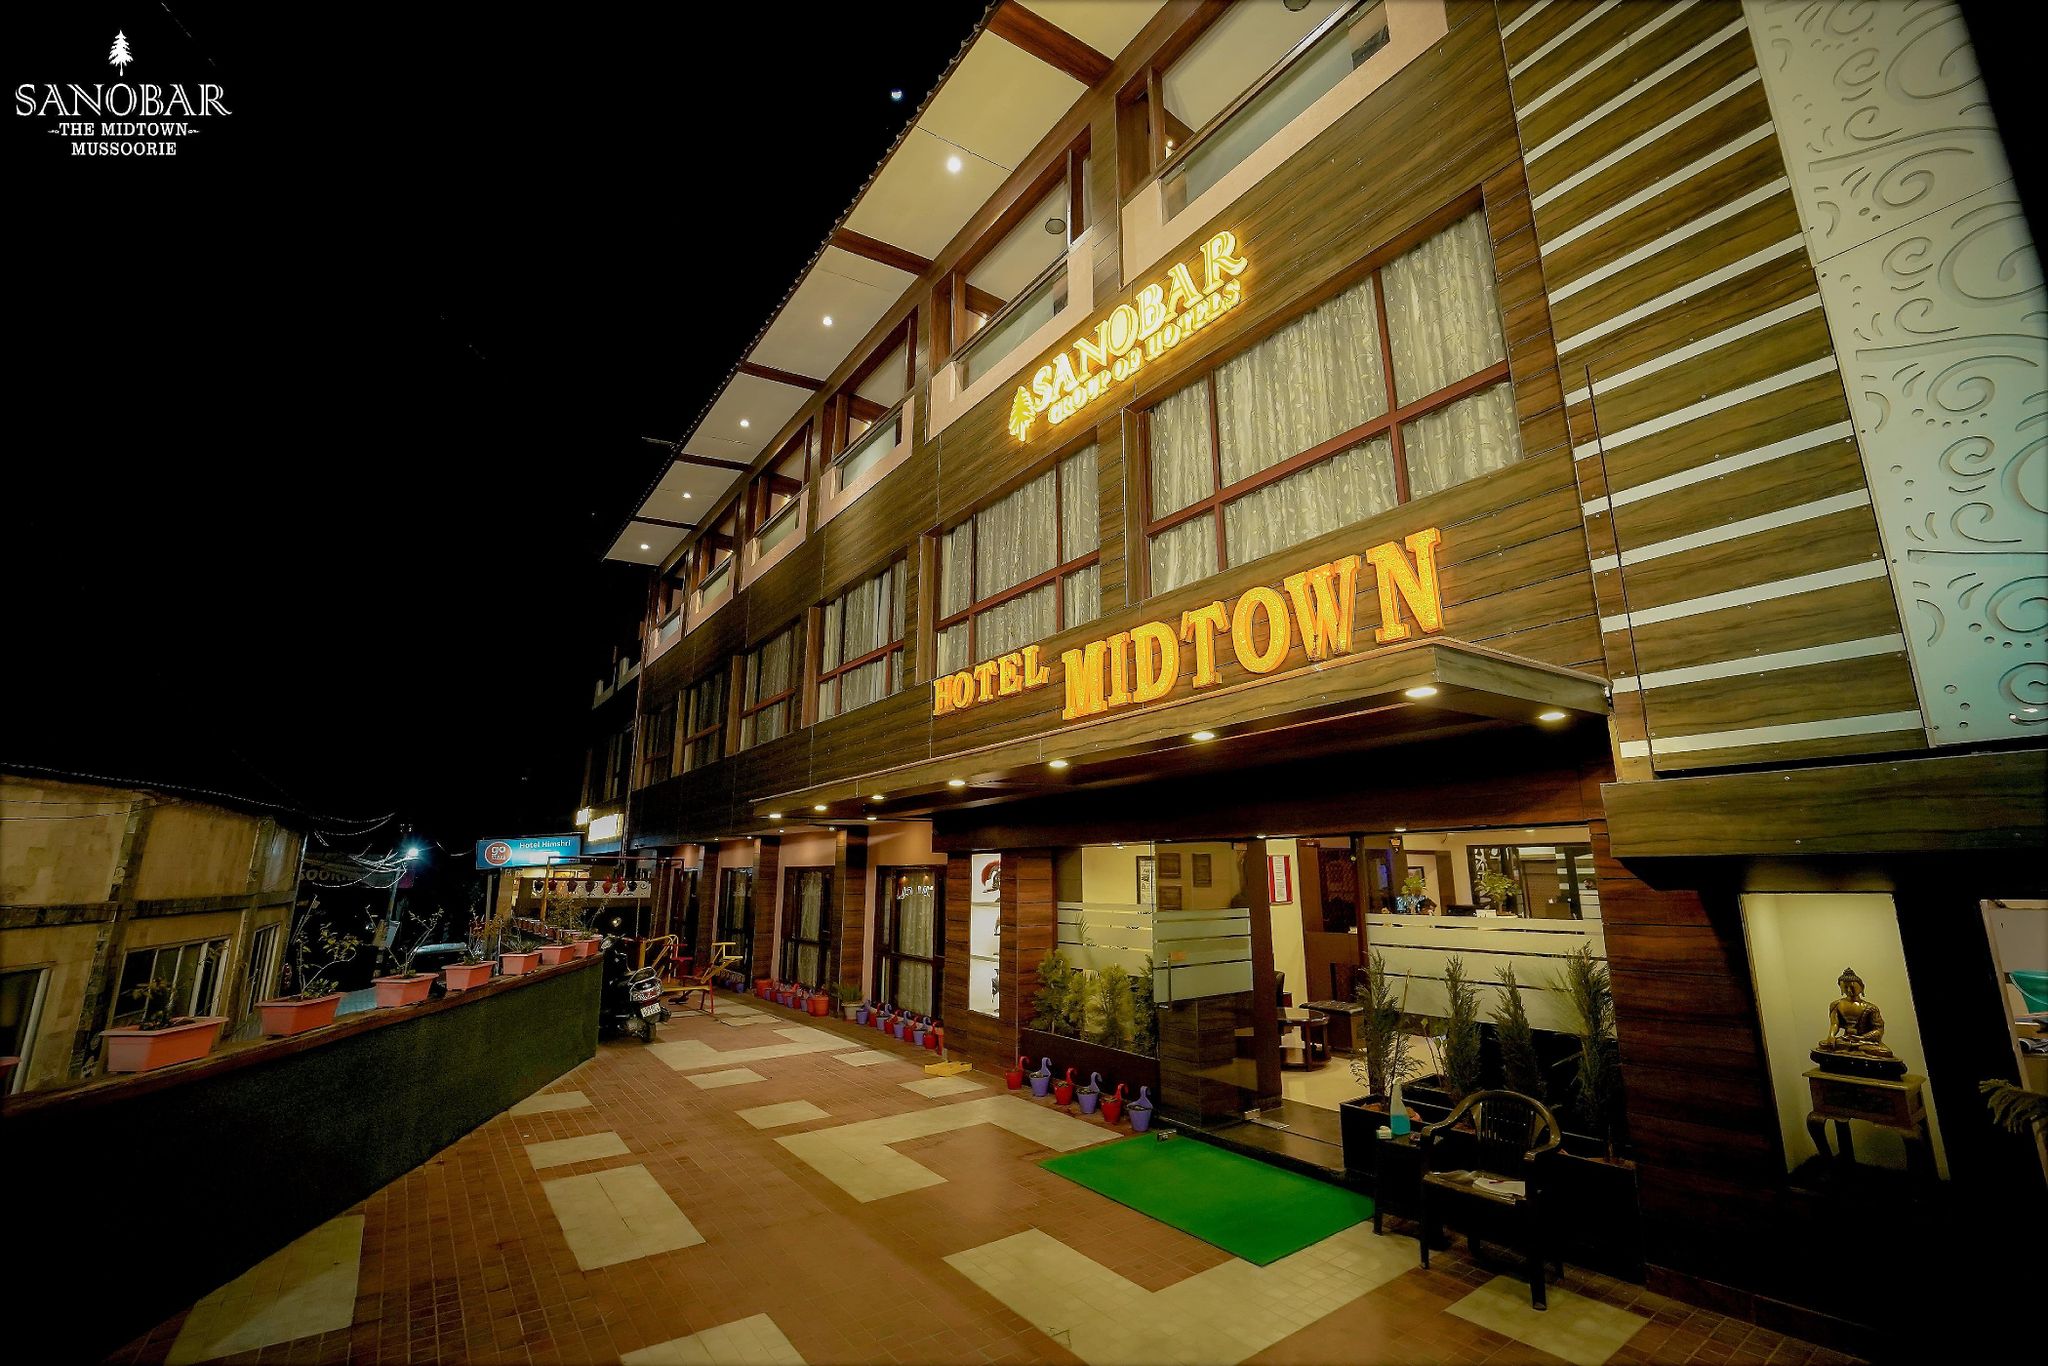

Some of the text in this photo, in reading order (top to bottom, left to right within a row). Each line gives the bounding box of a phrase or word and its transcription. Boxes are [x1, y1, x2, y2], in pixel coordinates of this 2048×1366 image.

[1032, 230, 1248, 413] SANOBAR
[1144, 278, 1242, 362] HOTELS
[932, 527, 1443, 721] HOTEL MIDTOWN
[519, 839, 571, 849] Hotel Himshri
